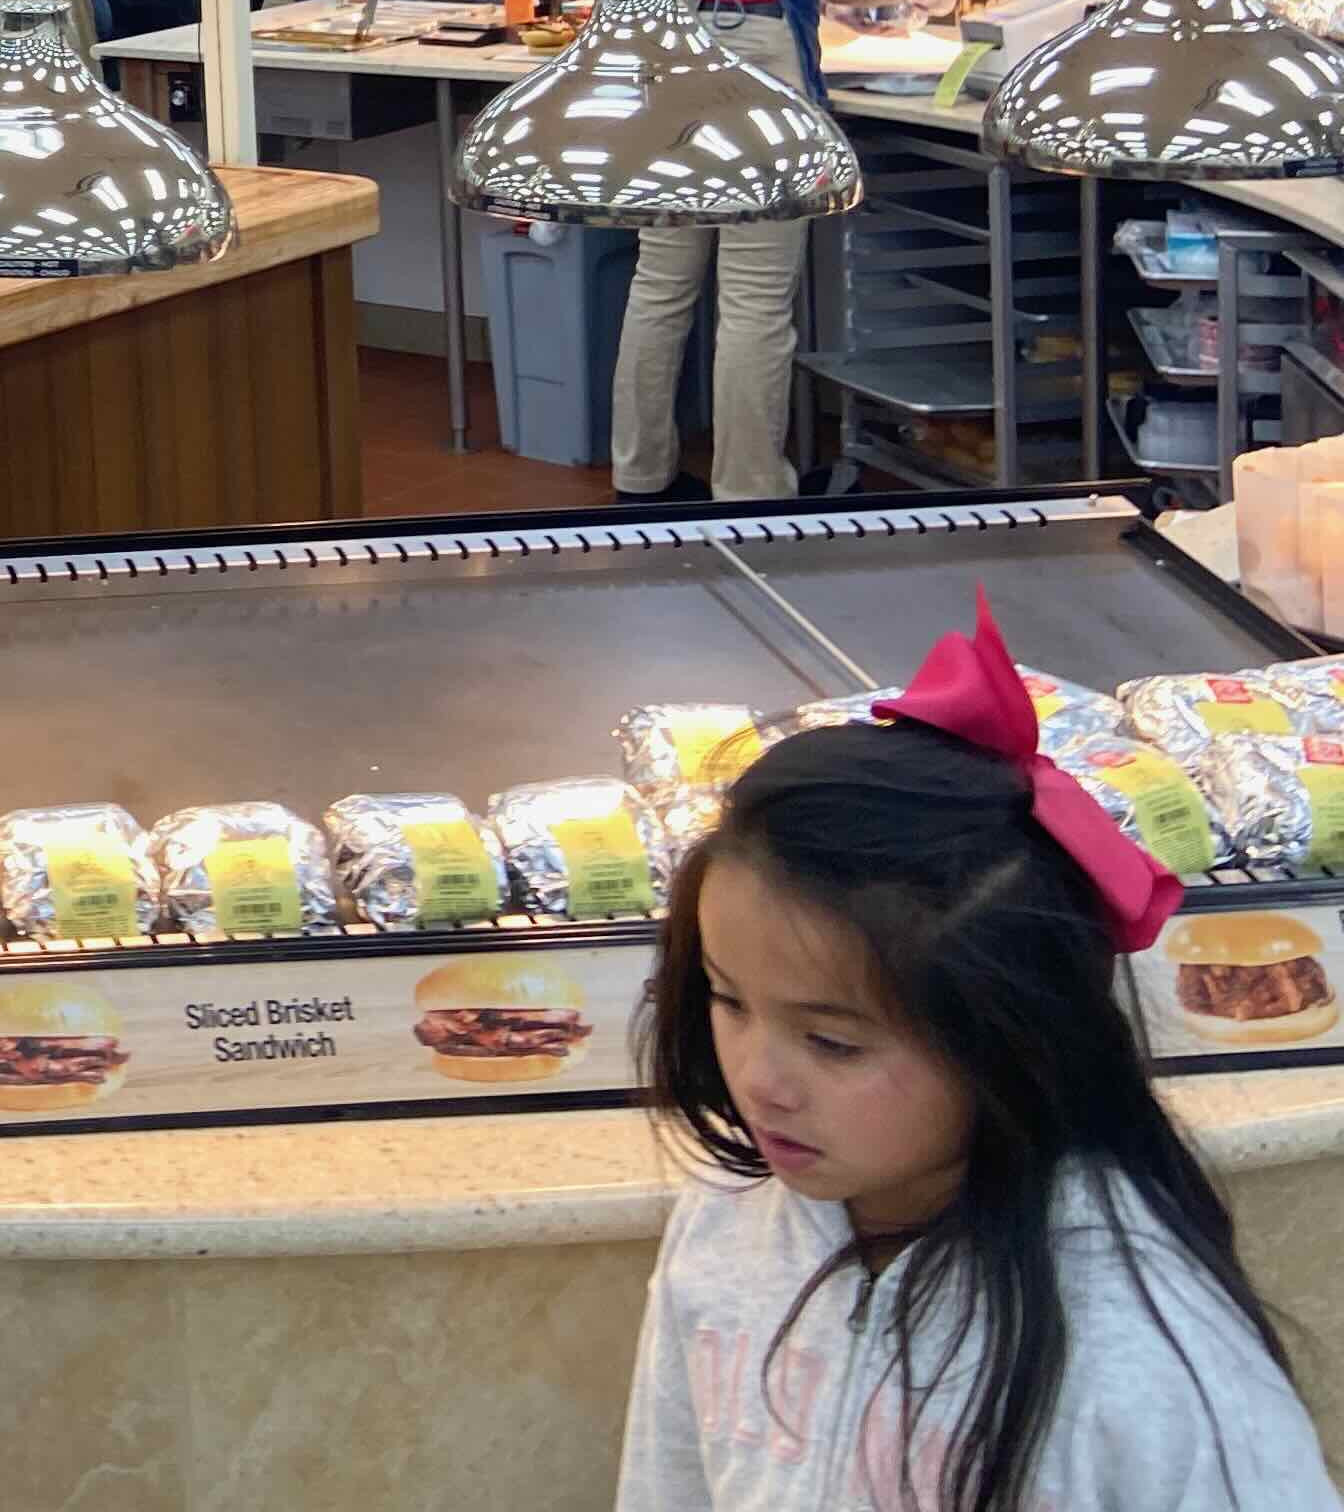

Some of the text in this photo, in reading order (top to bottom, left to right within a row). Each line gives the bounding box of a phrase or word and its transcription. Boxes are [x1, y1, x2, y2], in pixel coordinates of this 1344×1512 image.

[184, 996, 354, 1031] Sliced Brisket
[212, 1033, 337, 1064] Sandwich
